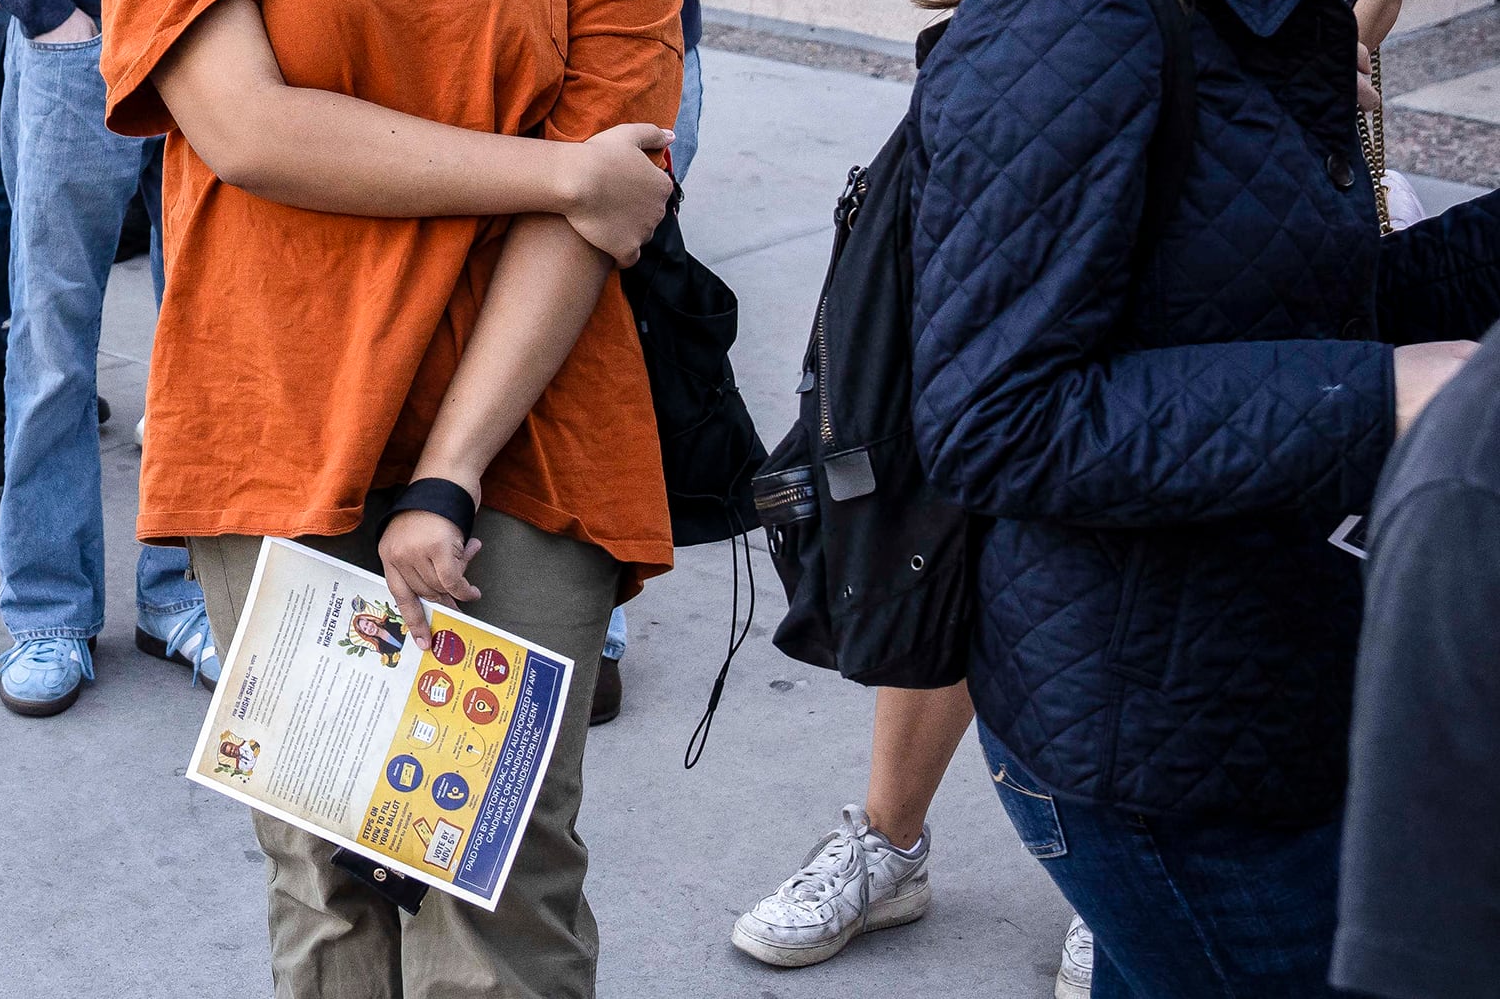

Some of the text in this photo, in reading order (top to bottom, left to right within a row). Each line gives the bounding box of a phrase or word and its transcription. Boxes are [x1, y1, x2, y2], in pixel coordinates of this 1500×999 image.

[322, 595, 344, 647] KIRSTEN ENGEL
[524, 683, 534, 696] BY
[526, 667, 538, 685] ANY
[237, 675, 258, 720] AMISH SHAH
[509, 695, 532, 747] AUTHORIZED
[485, 795, 507, 844] CANDIDATE
[502, 782, 512, 796] OR
[524, 700, 540, 729] AGENT.
[504, 748, 515, 766] NOT
[497, 765, 508, 785] PAC.
[502, 725, 542, 825] MAJOR FUNDER FPR INC.
[484, 784, 501, 821] VICTORY
[362, 806, 378, 839] STEPS ON
[370, 798, 391, 843] HOW TO FILL
[379, 799, 401, 847] YOUR BALLOT
[479, 819, 489, 832] BY
[432, 829, 449, 859] VOTE BY
[440, 845, 452, 863] NOV.
[473, 831, 484, 851] FOR
[465, 849, 478, 871] PAID
